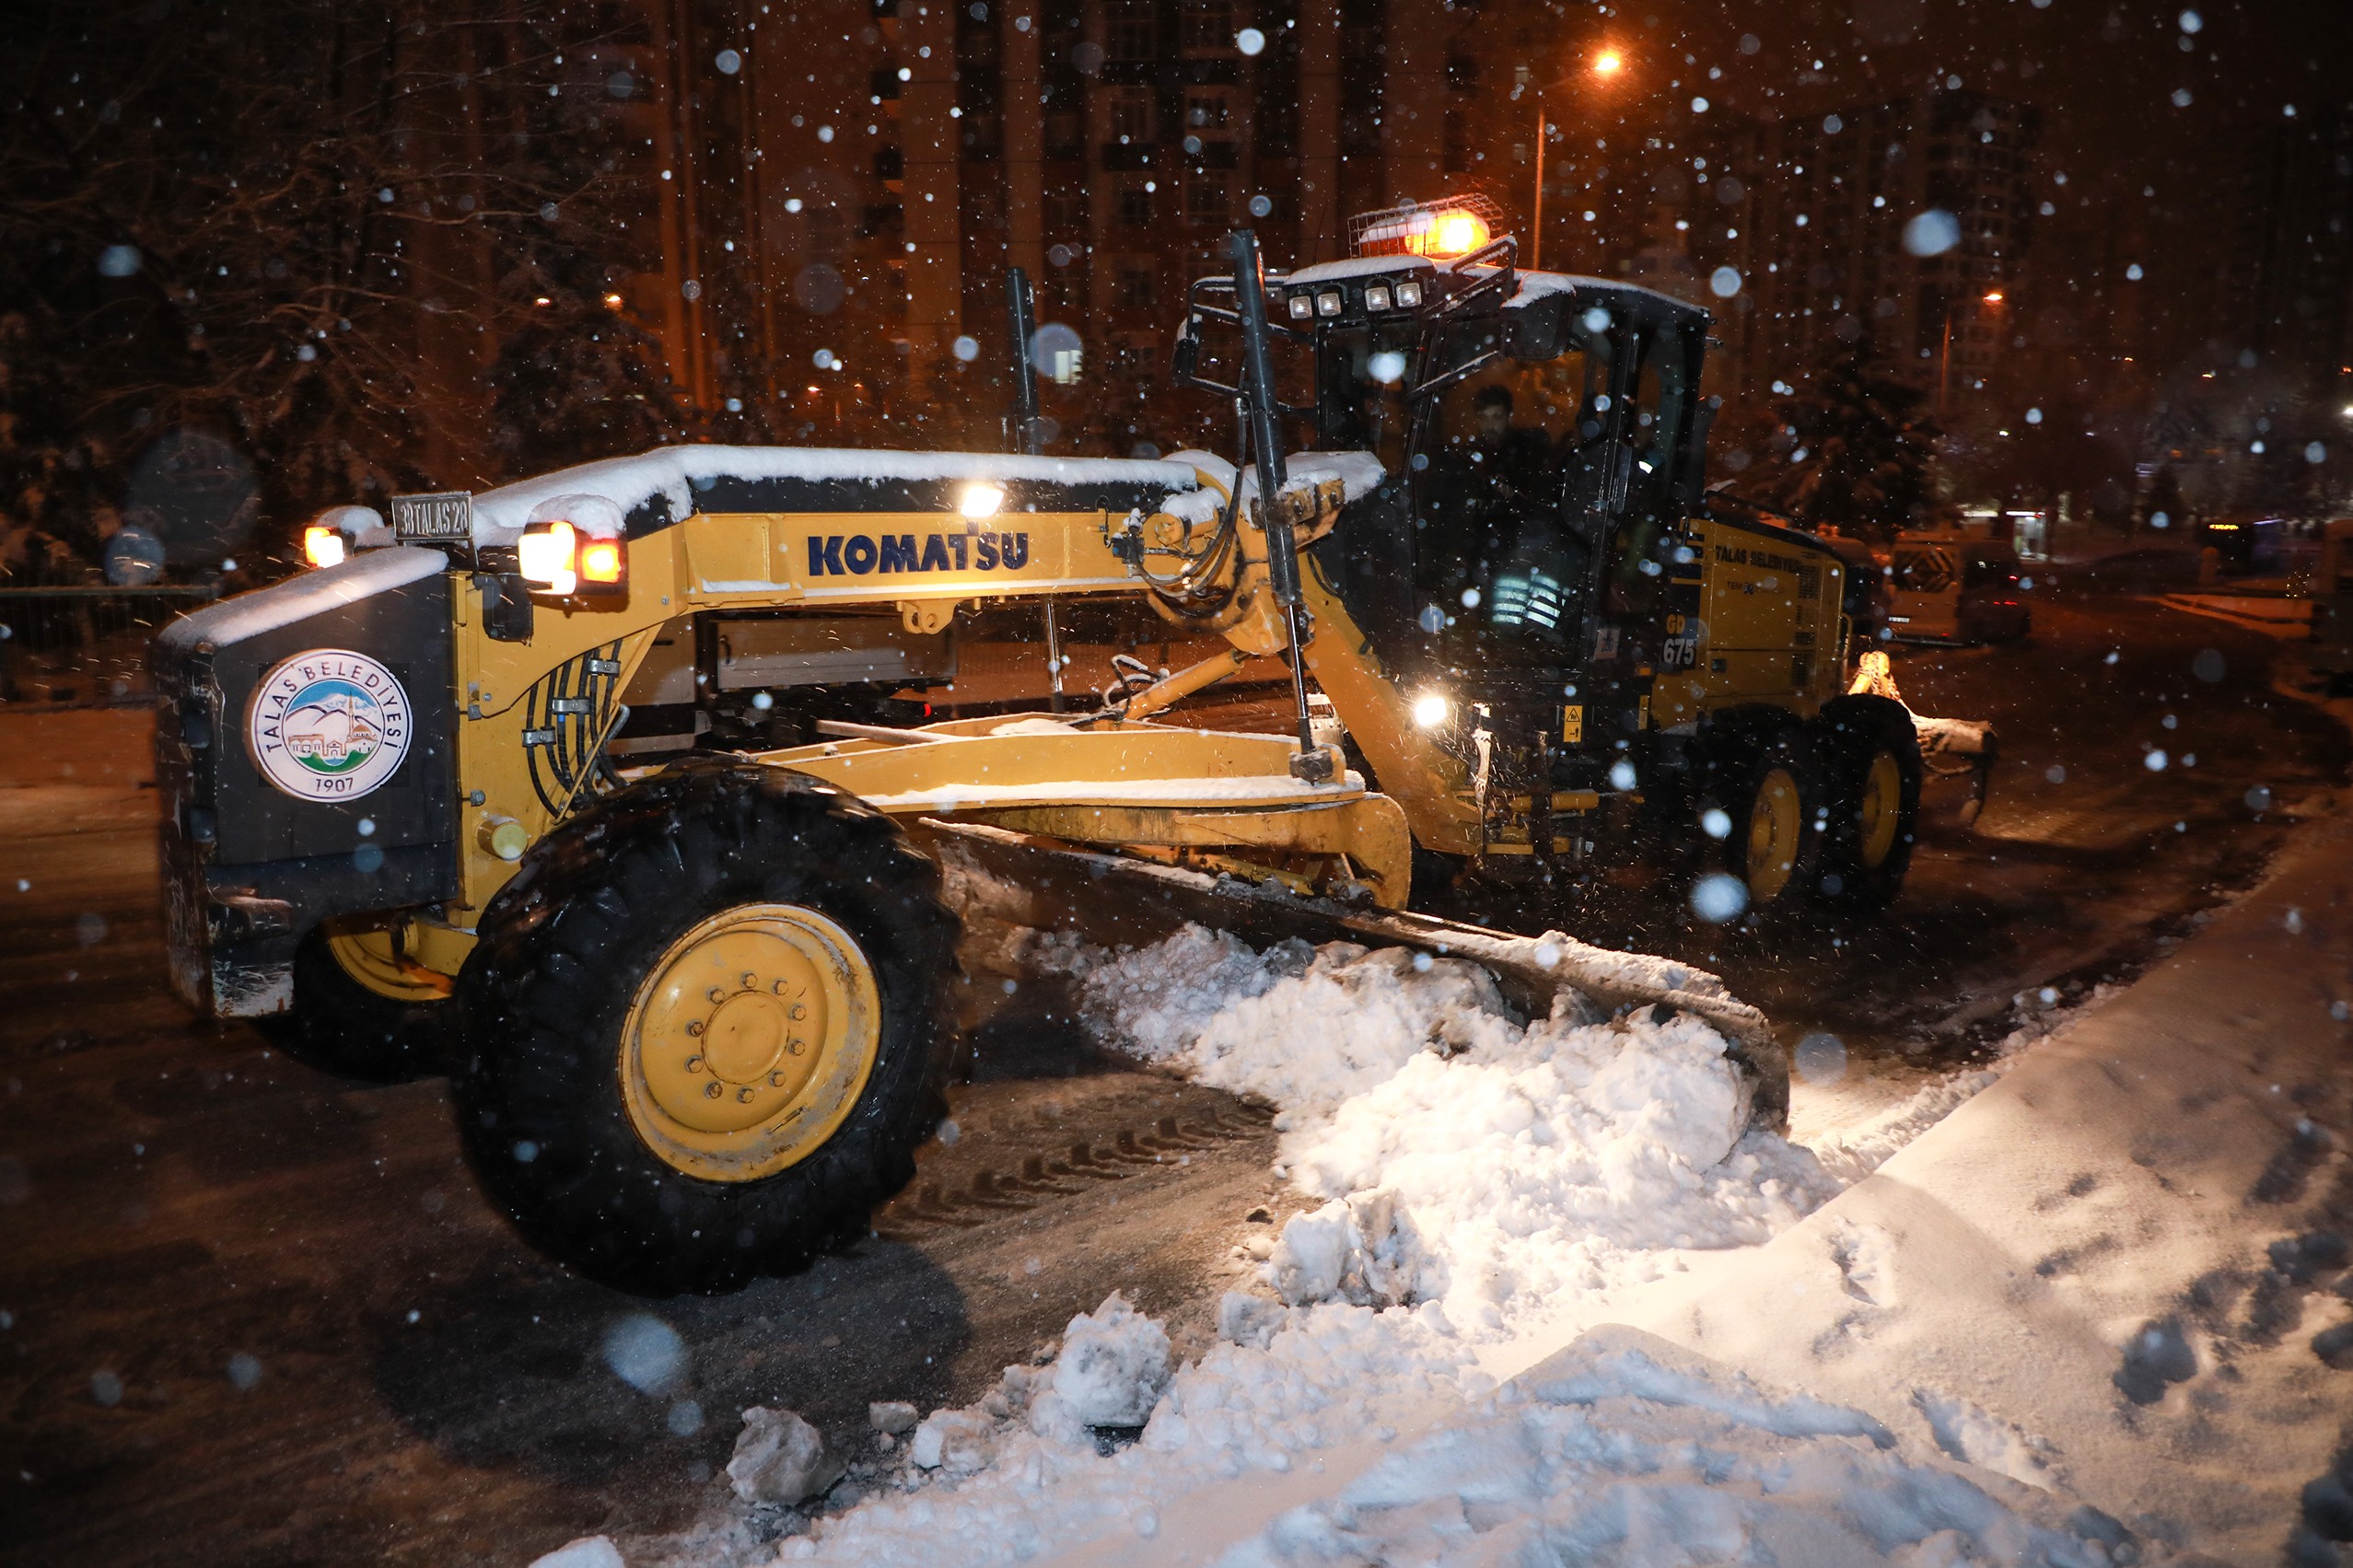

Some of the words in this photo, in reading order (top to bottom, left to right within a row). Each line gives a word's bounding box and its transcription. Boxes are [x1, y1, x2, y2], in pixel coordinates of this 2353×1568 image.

[414, 502, 450, 534] TALAS
[808, 532, 1029, 576] KOMATSU
[1716, 545, 1747, 564] TALAS
[1666, 612, 1686, 634] GD
[1663, 638, 1695, 665] 675
[263, 679, 297, 753] TALAS
[303, 661, 402, 749] BELEDİYESİ
[316, 777, 355, 793] 1907
